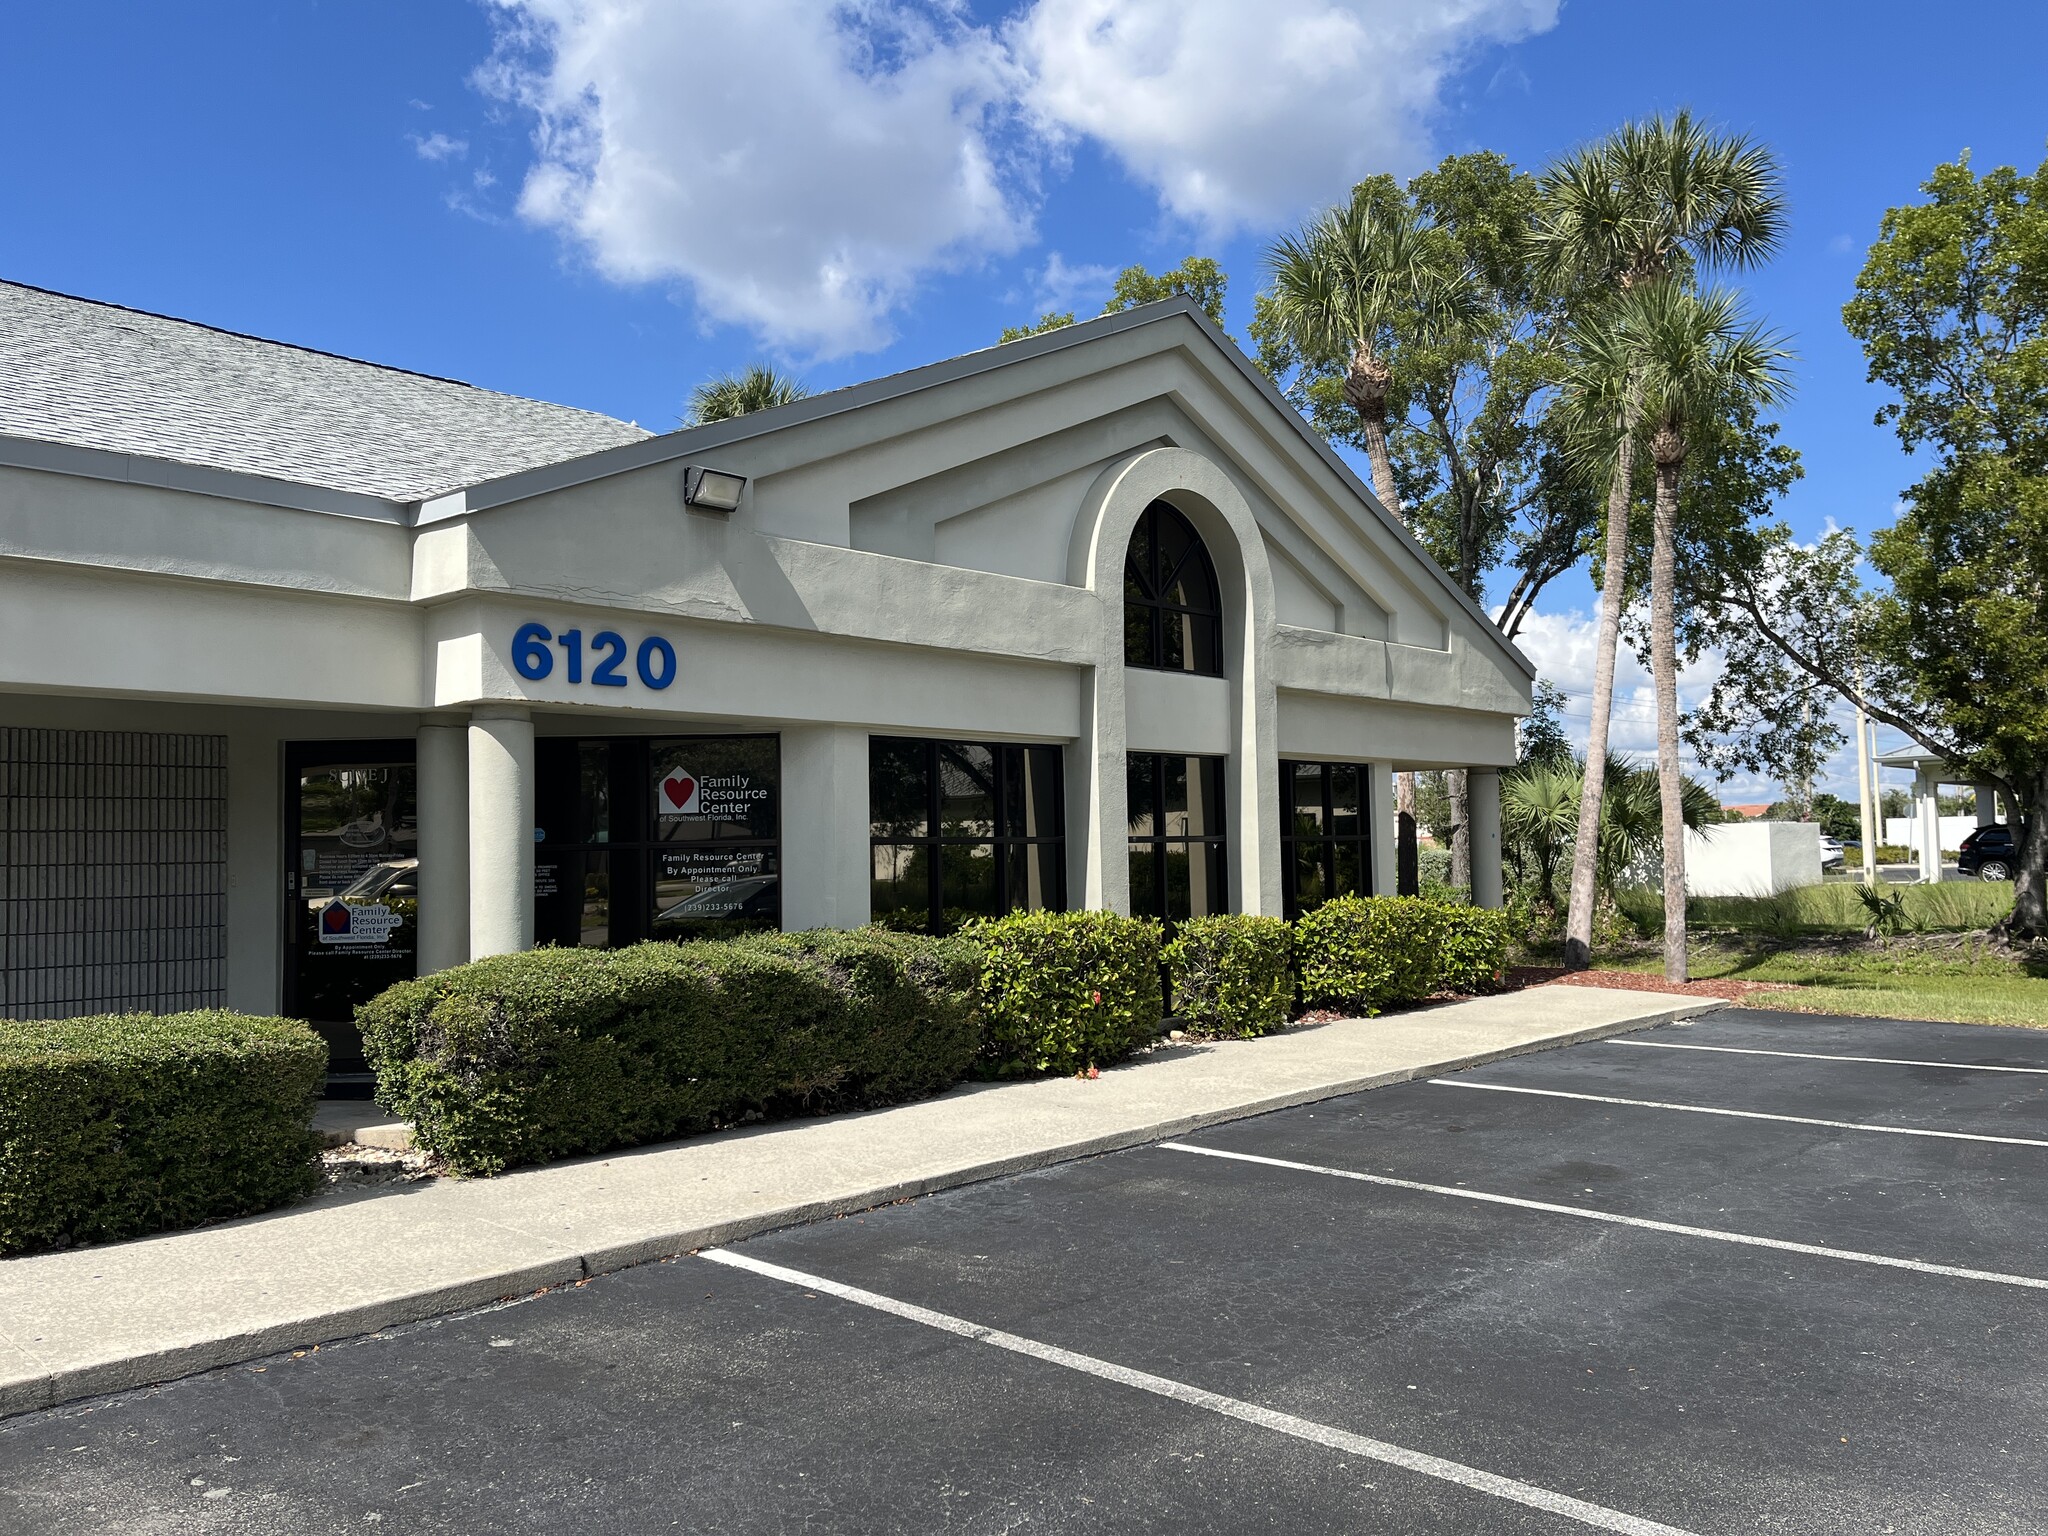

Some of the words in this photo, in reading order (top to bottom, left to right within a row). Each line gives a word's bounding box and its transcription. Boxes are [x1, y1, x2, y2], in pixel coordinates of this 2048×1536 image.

[512, 622, 677, 690] 6120
[329, 768, 378, 782] SUITE
[380, 768, 389, 784] J
[700, 775, 750, 789] Family
[700, 788, 768, 801] Resource
[700, 801, 751, 814] Center
[668, 814, 706, 822] Southwest
[662, 854, 691, 863] Family
[693, 853, 734, 861] Resource
[736, 852, 764, 860] Center
[667, 866, 678, 875] By
[680, 866, 736, 875] Appointment
[690, 875, 719, 883] Please
[352, 907, 388, 917] Family
[684, 902, 744, 912] (239)233-5676
[352, 916, 400, 925] Resource
[352, 926, 388, 935] Center
